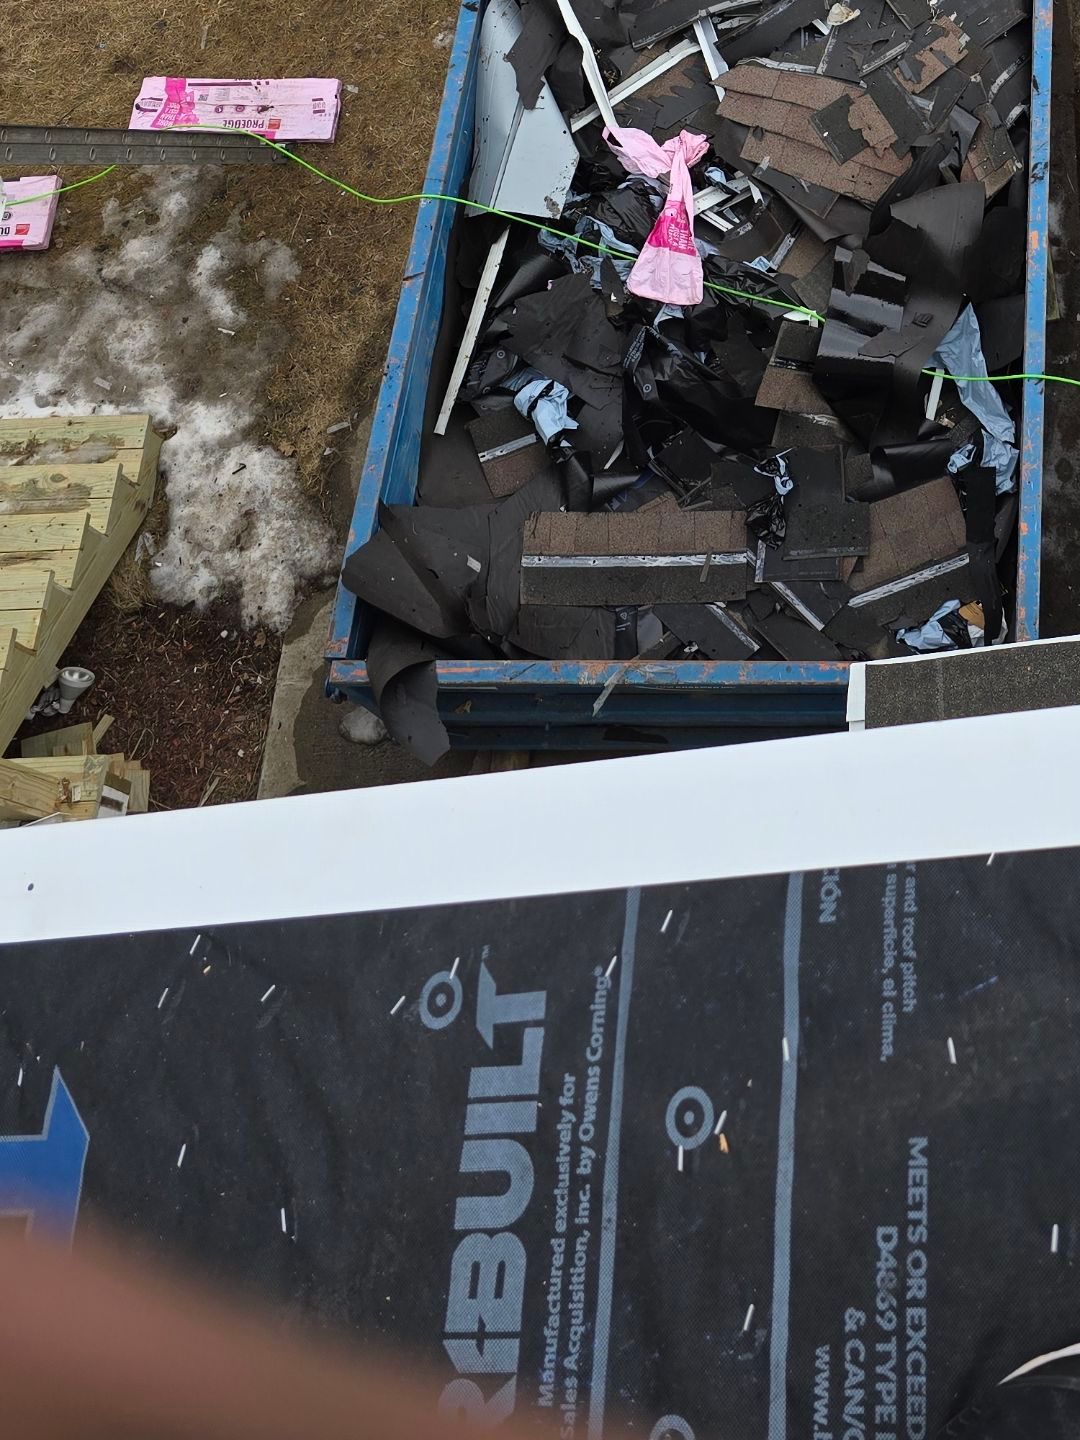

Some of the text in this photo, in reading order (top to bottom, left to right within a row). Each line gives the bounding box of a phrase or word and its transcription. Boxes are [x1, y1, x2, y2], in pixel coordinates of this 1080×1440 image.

[904, 876, 918, 913] and
[881, 873, 898, 975] superficie,
[902, 917, 917, 958] roof
[882, 977, 897, 998] el
[900, 962, 918, 1013] pitch
[880, 1001, 898, 1062] clima,
[578, 1065, 601, 1142] Owens
[576, 1146, 596, 1176] by
[907, 1136, 928, 1244] MEETS
[538, 1072, 577, 1407] Manufactured exclusively for
[564, 1229, 590, 1373] Acquisition,
[906, 1249, 928, 1300] OR
[844, 1307, 866, 1333] &
[875, 1336, 897, 1425] TYPE
